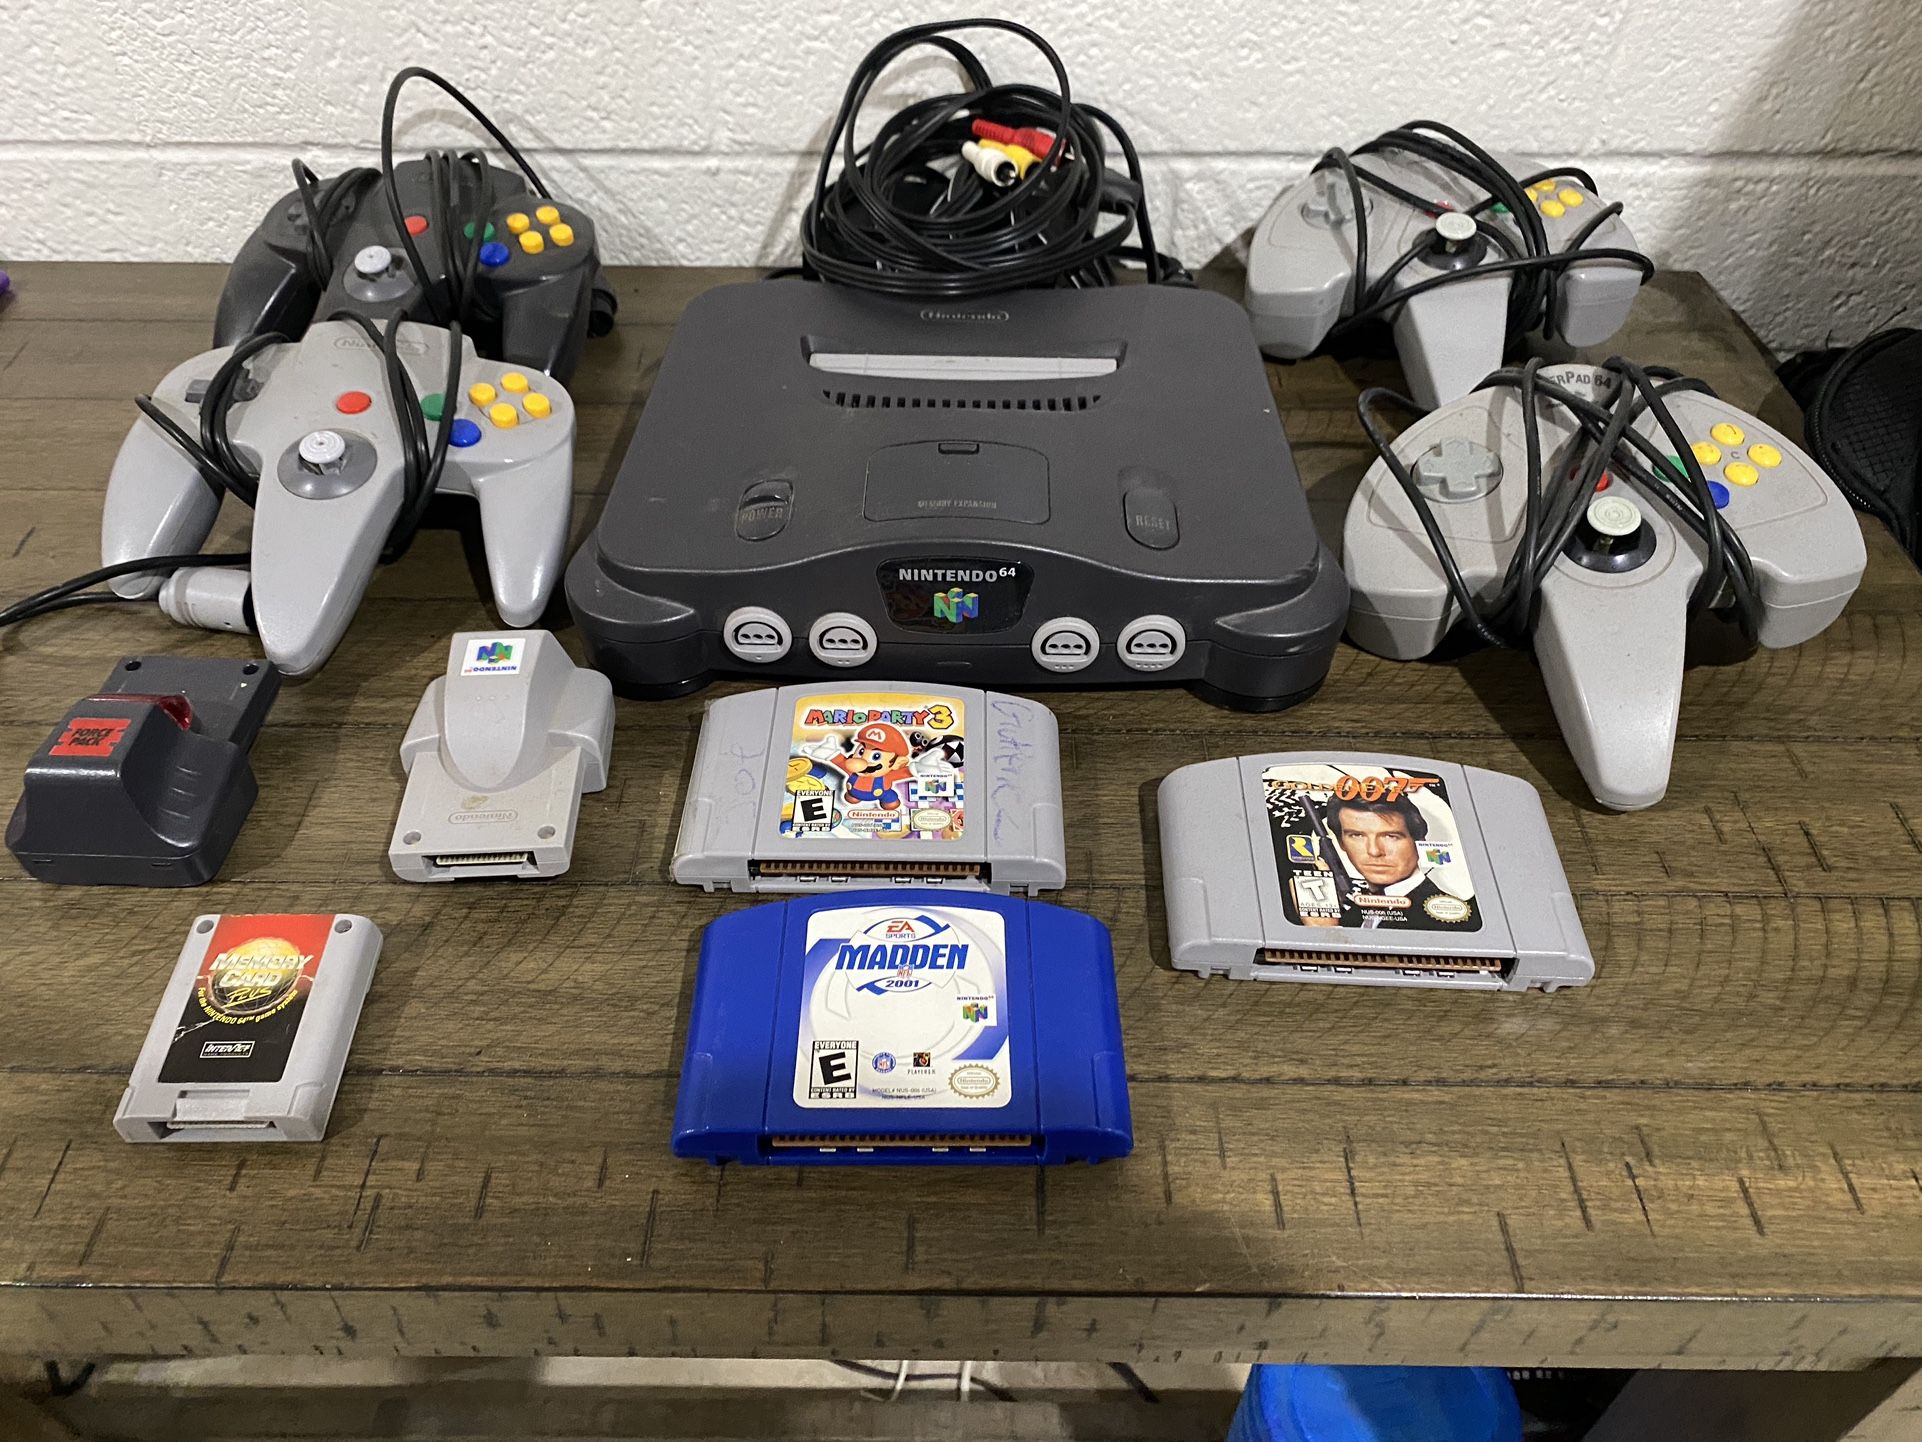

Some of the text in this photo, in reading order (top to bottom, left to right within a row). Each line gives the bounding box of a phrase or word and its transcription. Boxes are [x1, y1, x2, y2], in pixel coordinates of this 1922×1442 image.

[1594, 375, 1612, 389] 64
[742, 506, 784, 523] POWER
[1135, 515, 1170, 531] RESET
[899, 568, 998, 582] NINTENDO
[926, 704, 955, 730] 3
[71, 728, 115, 738] FORCE
[68, 737, 106, 746] PACK
[1335, 775, 1440, 803] 007
[800, 797, 827, 822] E
[851, 811, 896, 819] Nintendo
[1293, 869, 1334, 878] TEEN
[1301, 880, 1325, 901] T
[1358, 897, 1407, 906] Nintendo
[886, 920, 915, 933] EA
[208, 952, 315, 971] MEMORY
[834, 944, 970, 970] MADDEN
[219, 969, 283, 988] CARD
[885, 979, 920, 988] 2001
[203, 1004, 238, 1025] NINTENDO
[814, 1041, 857, 1050] EVERYONE
[819, 1051, 852, 1086] E
